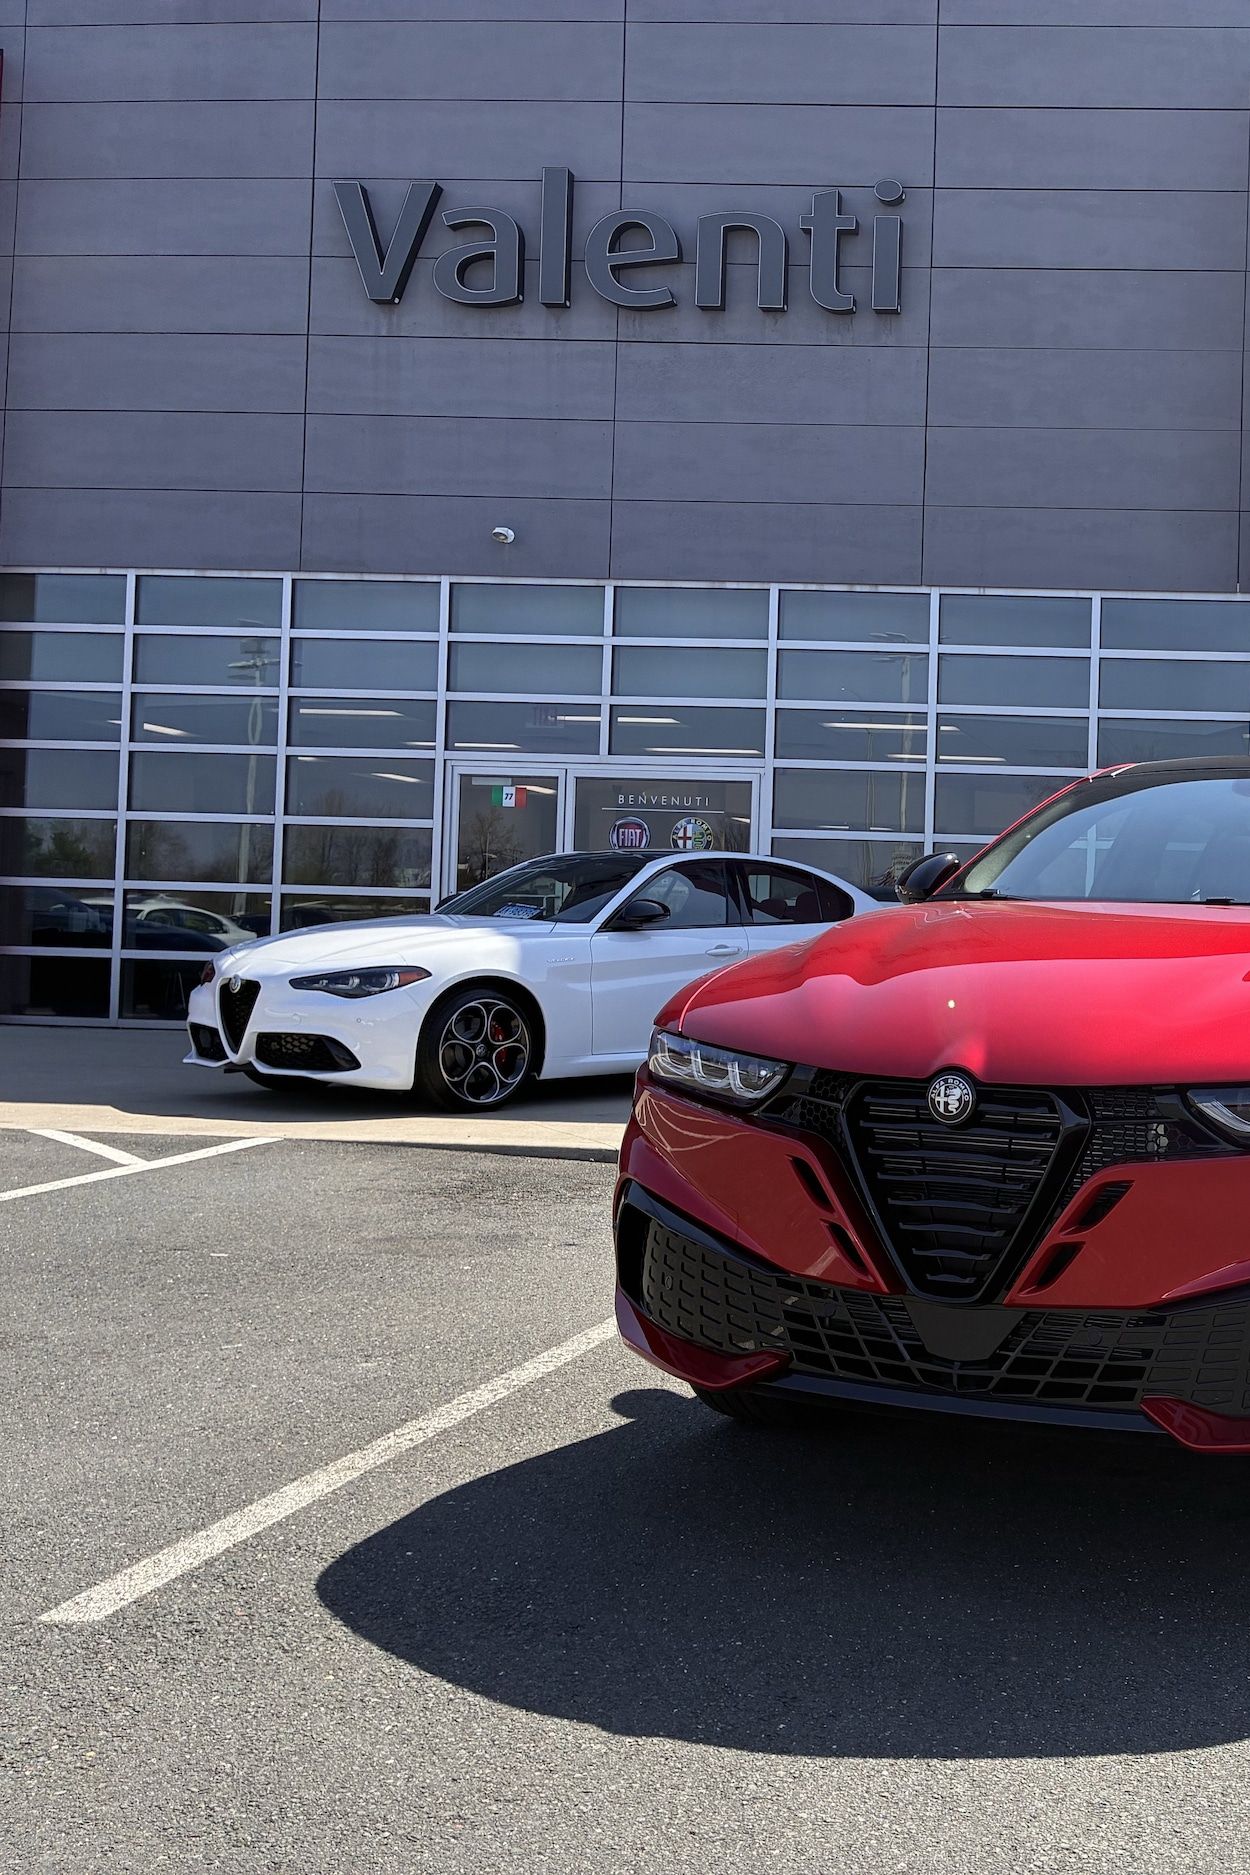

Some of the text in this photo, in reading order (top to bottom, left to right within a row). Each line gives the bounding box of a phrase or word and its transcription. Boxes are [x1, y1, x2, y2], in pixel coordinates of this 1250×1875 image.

[331, 166, 906, 315] Valenti
[504, 792, 514, 801] 77
[618, 794, 710, 807] BENVENUTI
[619, 828, 641, 847] FIAT
[673, 818, 712, 841] ALFA ROMEO
[931, 1078, 969, 1102] ALFA ROMEO
